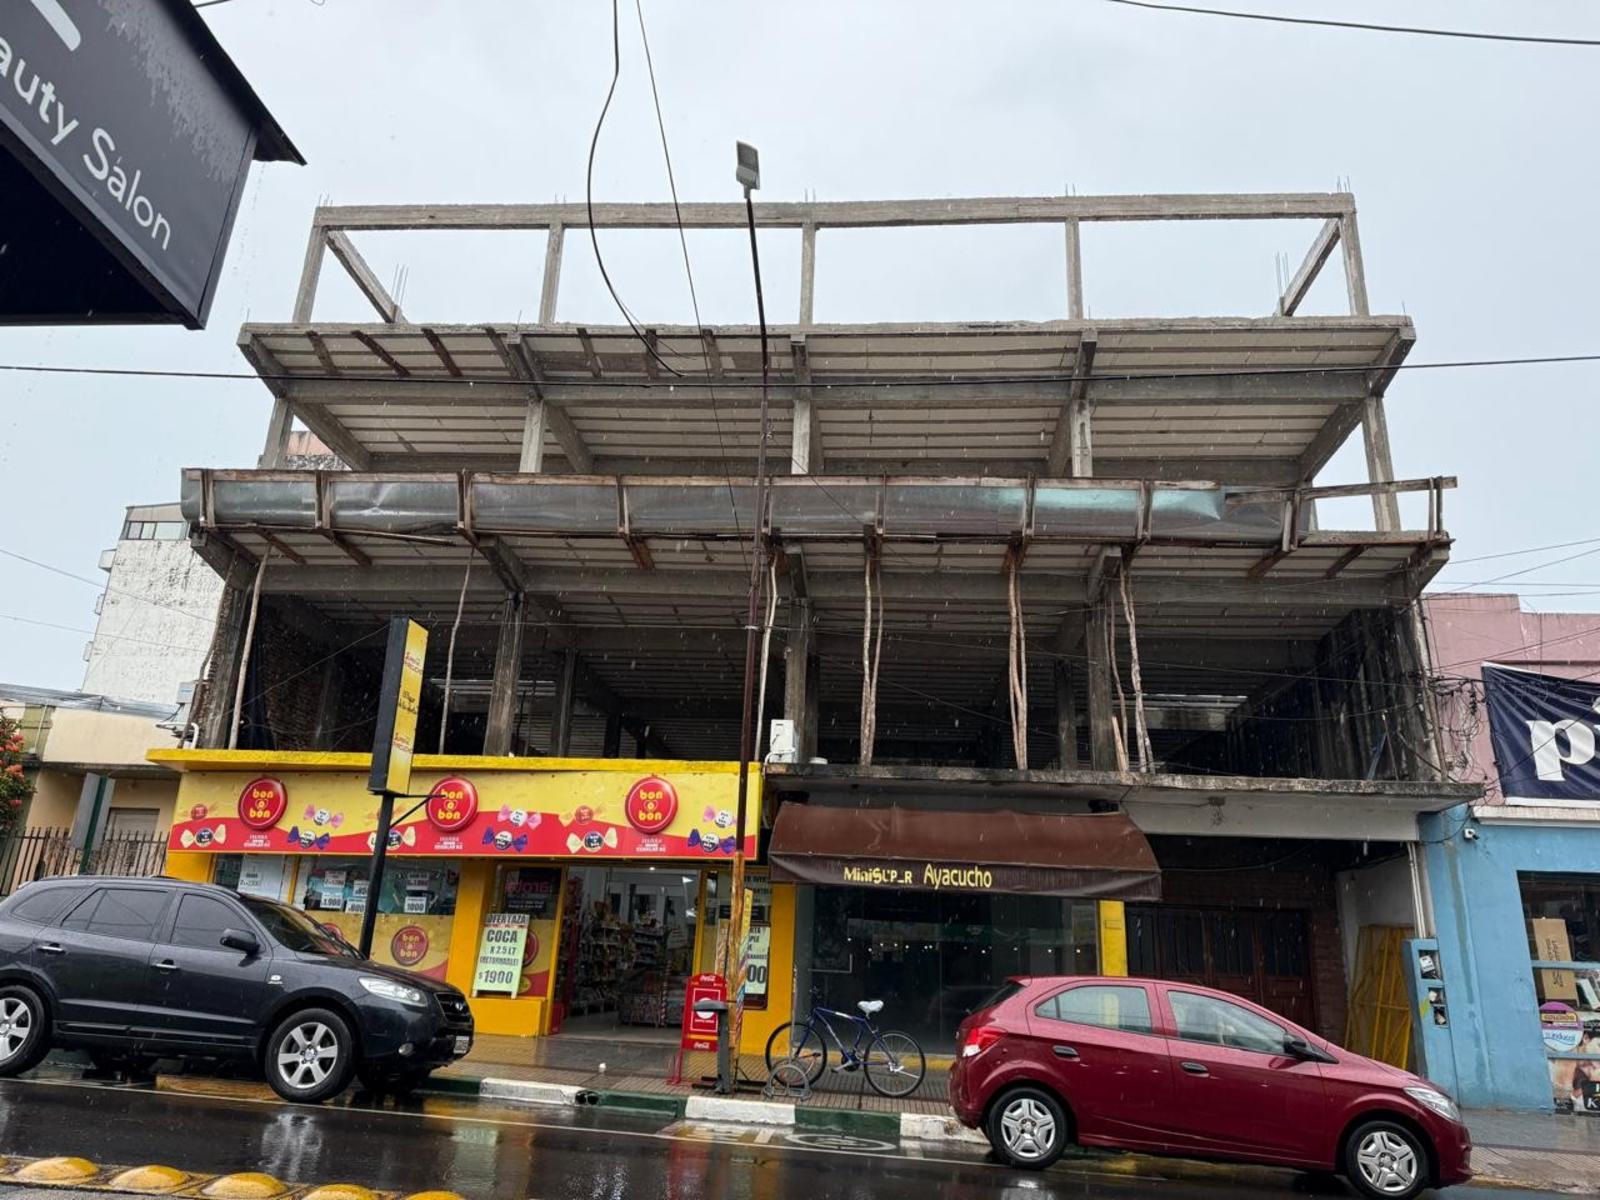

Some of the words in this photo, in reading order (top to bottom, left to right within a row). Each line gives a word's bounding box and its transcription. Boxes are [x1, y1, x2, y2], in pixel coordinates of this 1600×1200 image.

[83, 127, 172, 251] Salon
[1526, 697, 1600, 782] p
[252, 789, 274, 798] bon
[640, 790, 664, 799] bon
[249, 809, 271, 818] bon
[437, 811, 461, 820] bon
[638, 810, 662, 820] bon
[924, 863, 992, 890] Ayacucho
[402, 934, 419, 942] bon
[486, 929, 517, 943] COCA
[400, 950, 417, 958] bon
